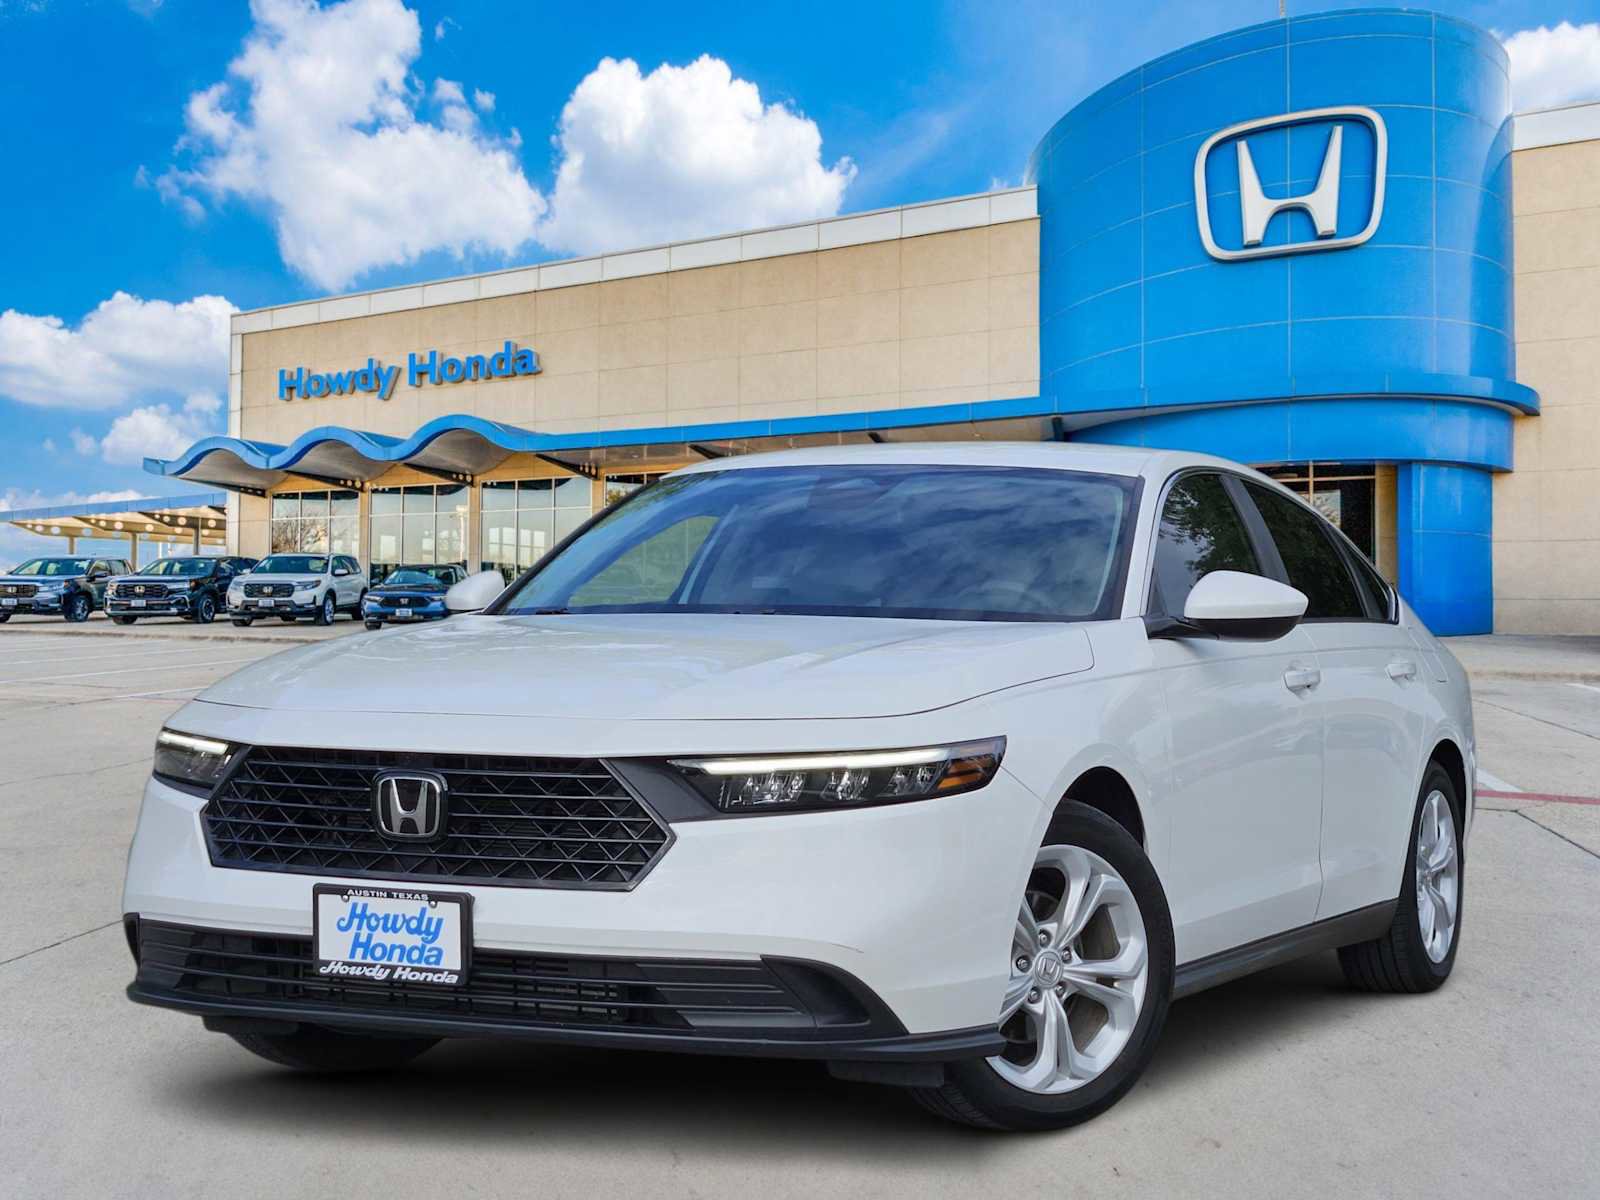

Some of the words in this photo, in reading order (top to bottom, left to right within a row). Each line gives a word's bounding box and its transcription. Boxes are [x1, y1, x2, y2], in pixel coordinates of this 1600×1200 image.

[278, 358, 400, 401] Howdy
[408, 340, 541, 388] Honda
[347, 889, 387, 898] AUSTIN
[392, 892, 429, 901] TEXAS
[337, 902, 444, 944] Howdy
[349, 932, 444, 966] Honda
[319, 961, 391, 980] Howdy
[393, 966, 459, 983] Honda
